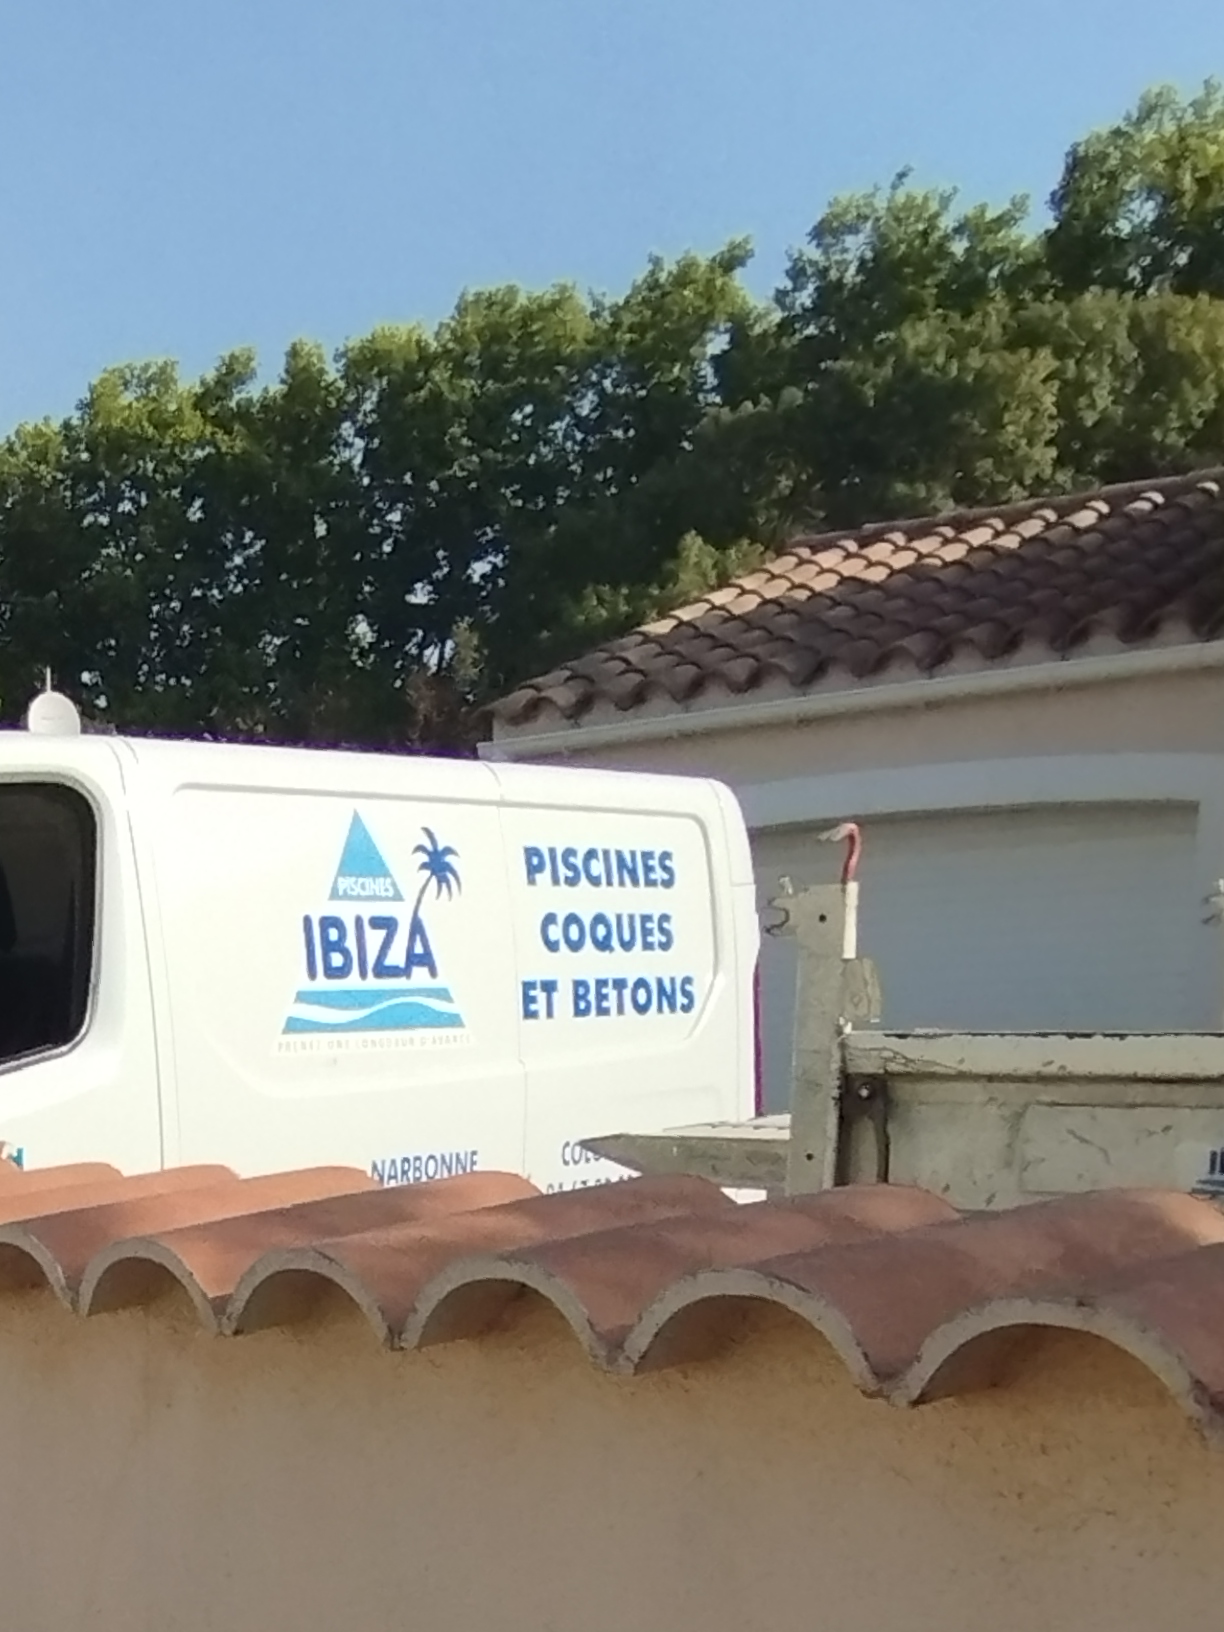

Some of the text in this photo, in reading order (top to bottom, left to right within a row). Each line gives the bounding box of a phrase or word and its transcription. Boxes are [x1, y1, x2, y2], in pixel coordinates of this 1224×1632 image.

[338, 876, 394, 898] PISCINES
[523, 846, 675, 889] PISCINES
[303, 914, 438, 981] IBIZA
[540, 912, 674, 954] COQUES
[522, 975, 695, 1020] ET BETONS
[370, 1150, 478, 1186] NARBONNE
